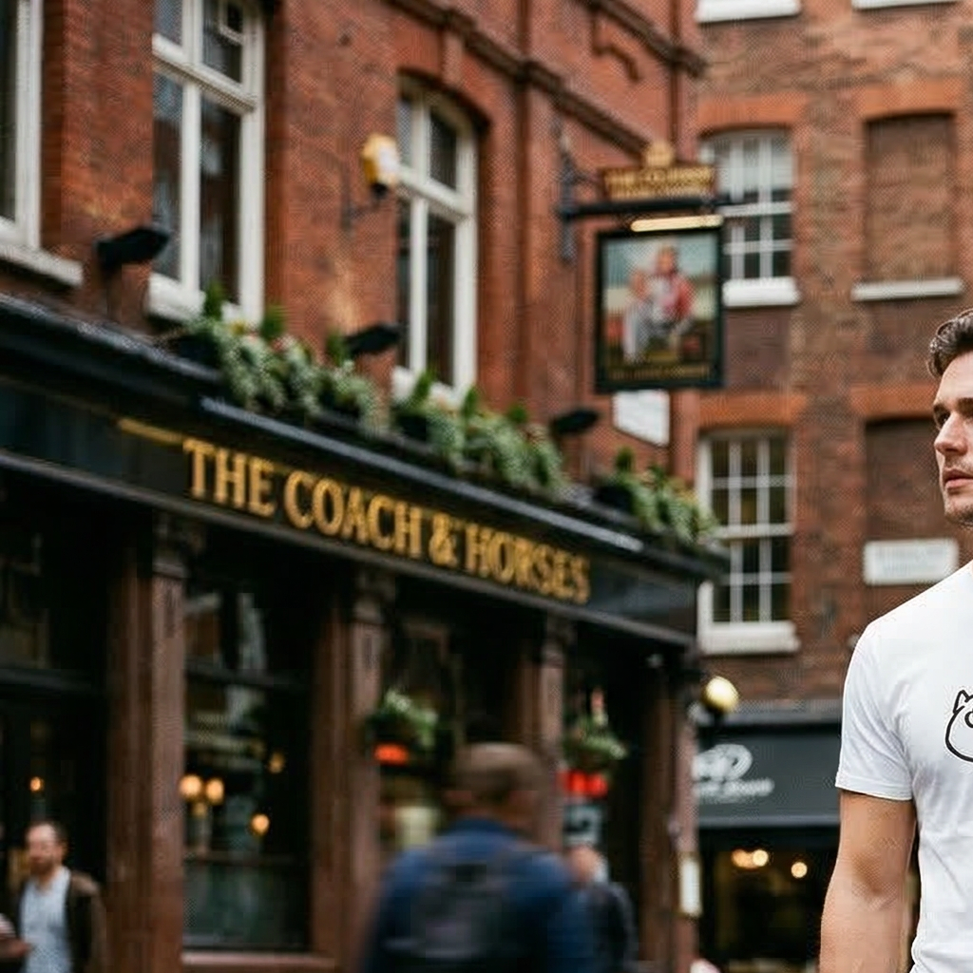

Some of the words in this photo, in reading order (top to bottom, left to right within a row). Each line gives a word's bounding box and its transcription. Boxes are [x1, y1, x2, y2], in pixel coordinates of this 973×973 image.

[183, 439, 276, 518] THE
[284, 471, 424, 560] COACH
[429, 513, 459, 567] &
[465, 521, 591, 605] HORSES
